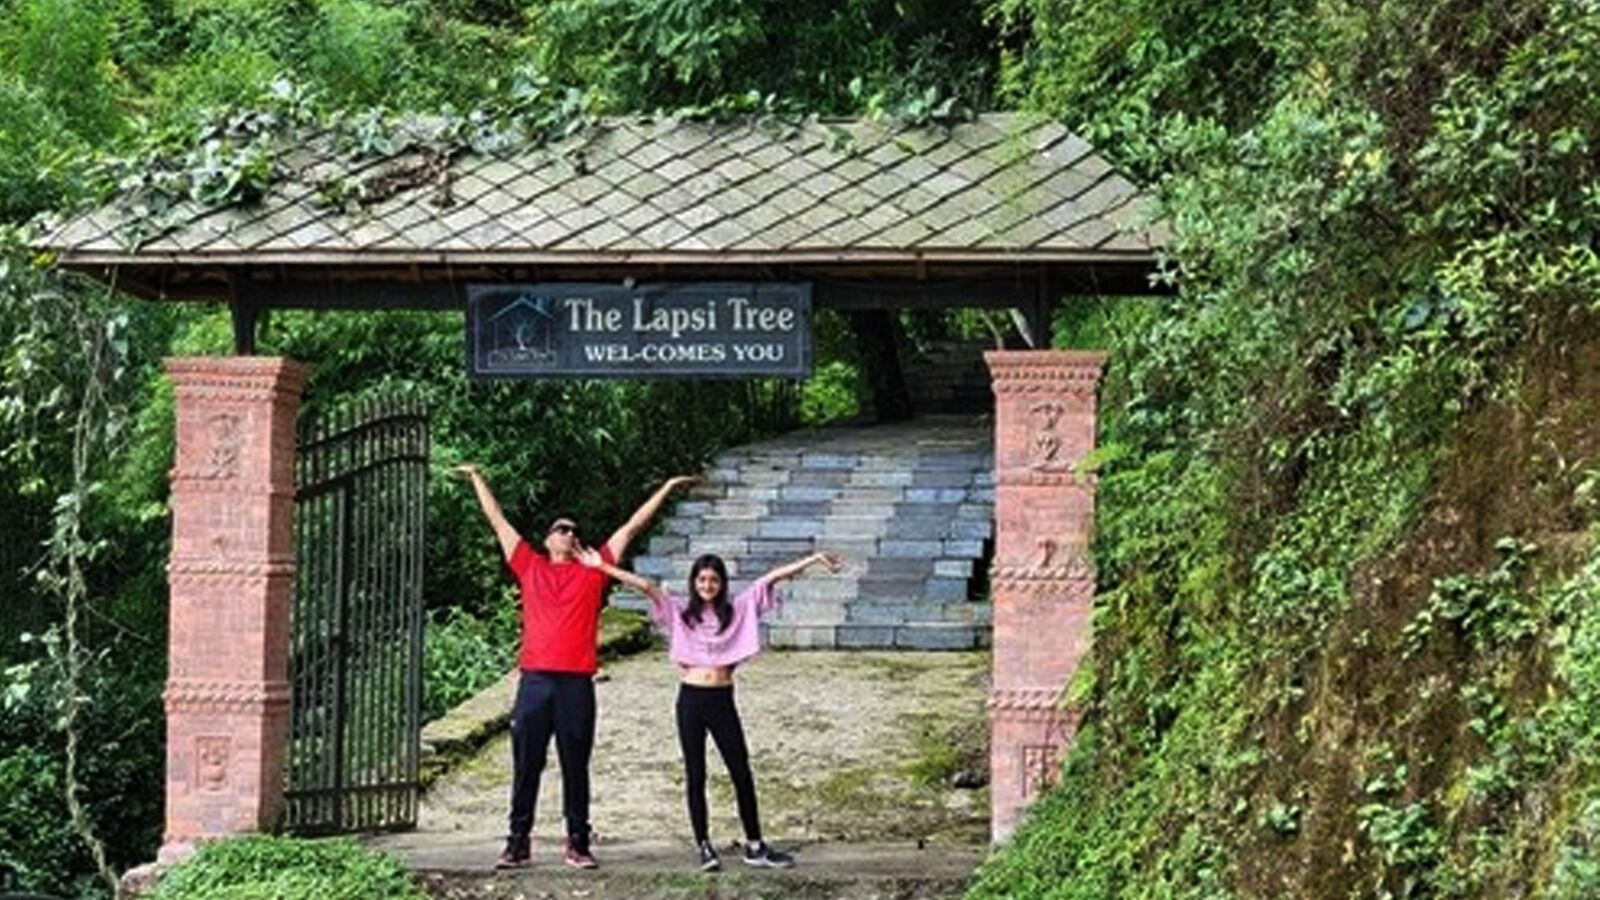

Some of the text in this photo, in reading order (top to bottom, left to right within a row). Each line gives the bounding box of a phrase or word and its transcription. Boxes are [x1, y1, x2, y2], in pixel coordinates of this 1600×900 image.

[565, 298, 795, 338] The Lapsi Tree
[584, 344, 785, 362] WEL-COMES YOU
